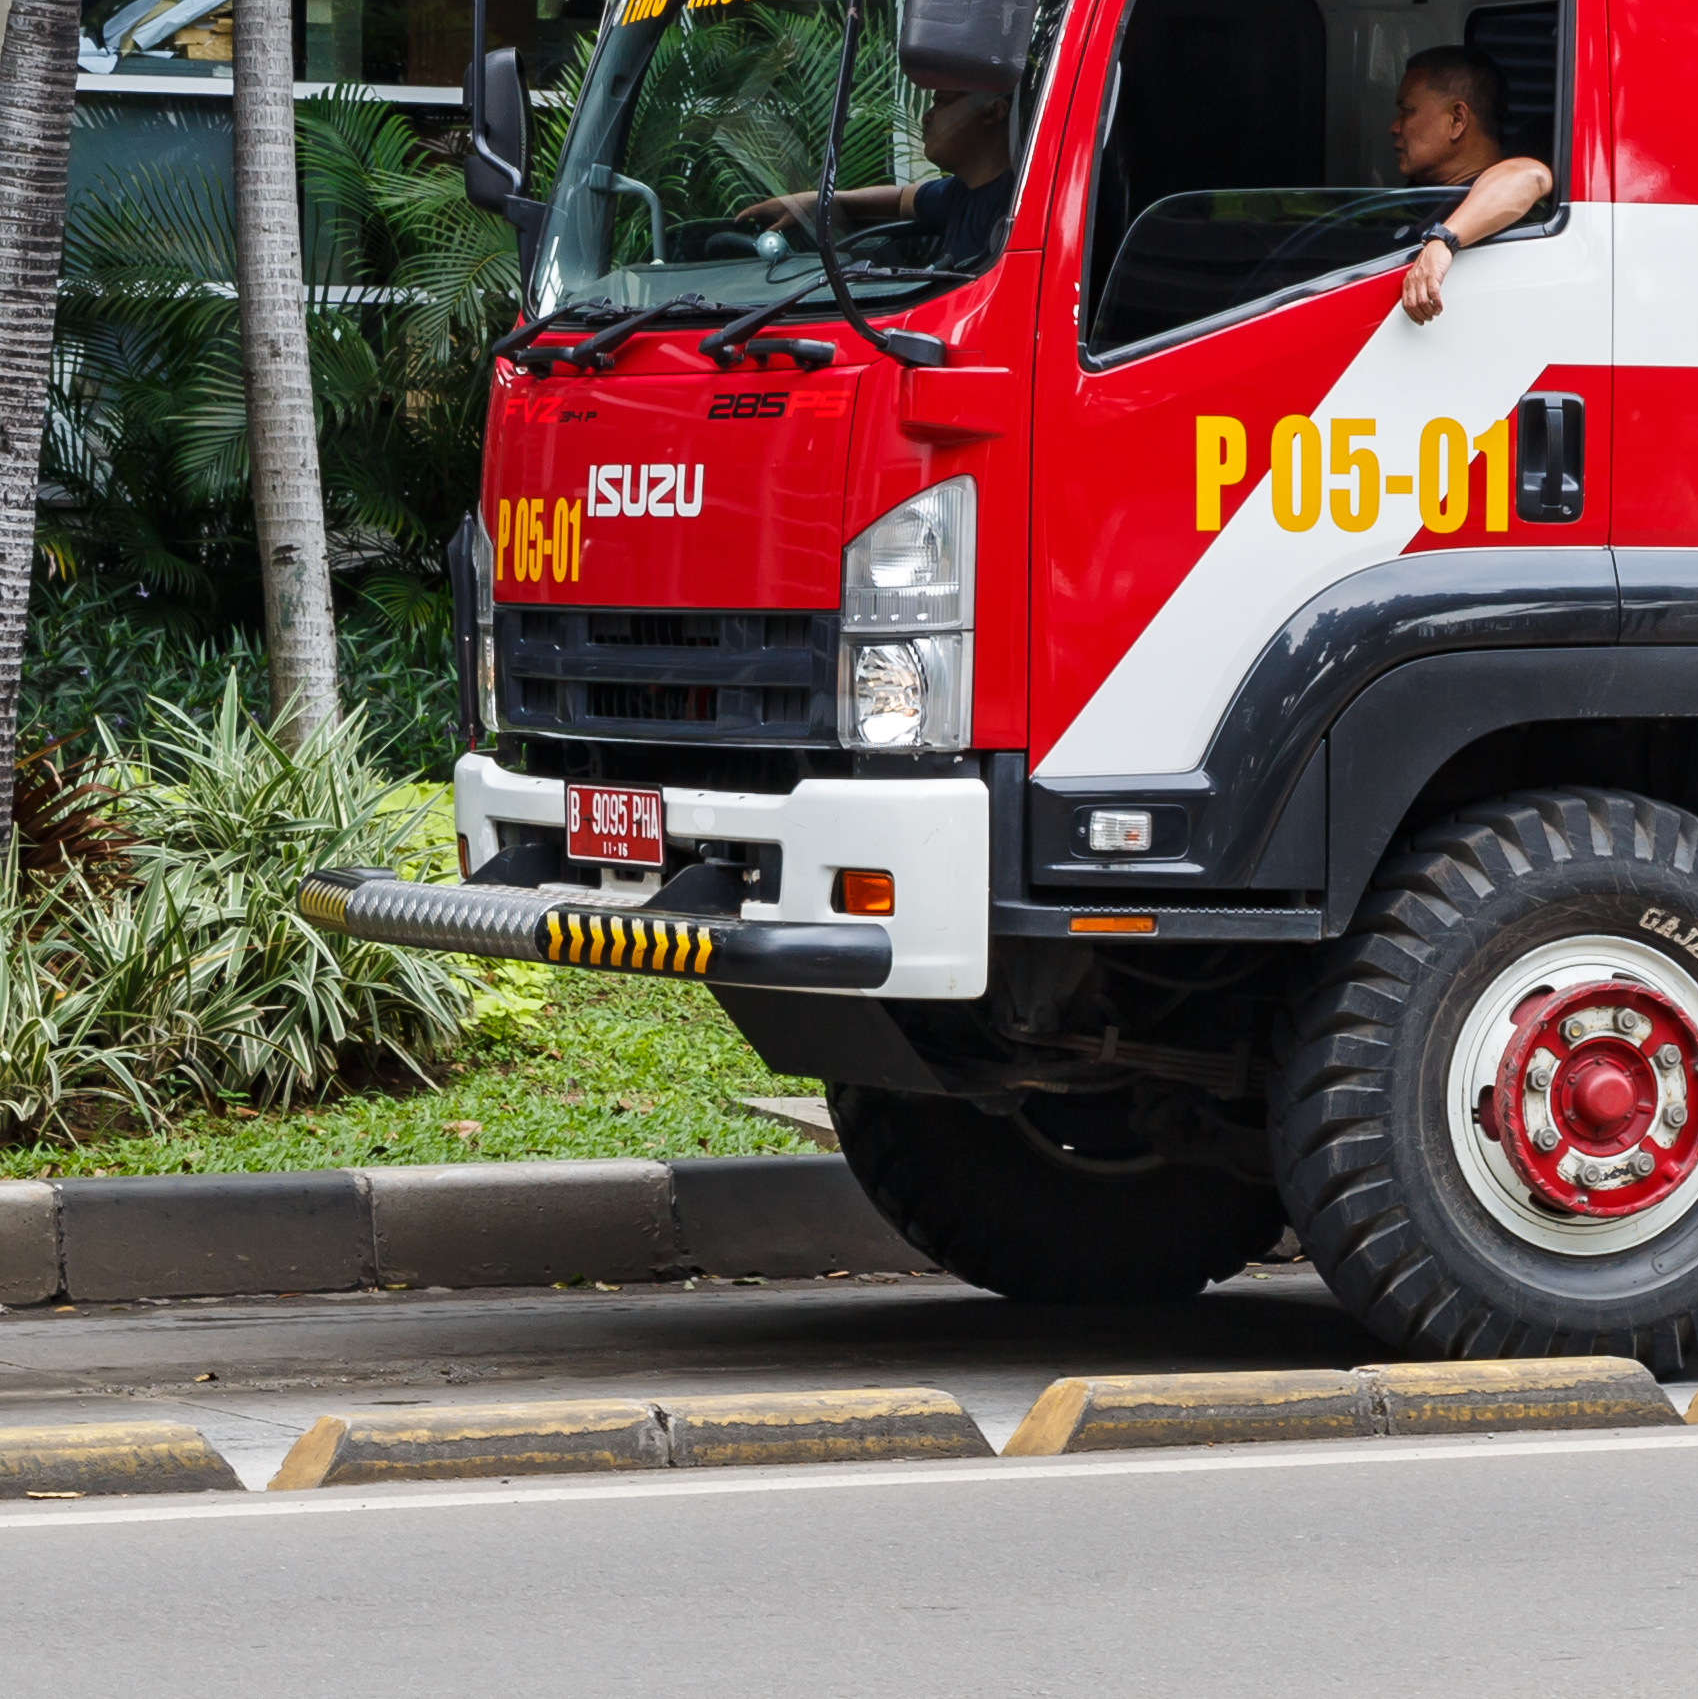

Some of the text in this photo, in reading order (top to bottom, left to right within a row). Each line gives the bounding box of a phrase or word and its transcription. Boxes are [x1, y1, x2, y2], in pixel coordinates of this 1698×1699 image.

[587, 464, 704, 517] ISUZU
[1196, 414, 1510, 534] P 05-01
[496, 496, 582, 583] P 05-01
[570, 790, 659, 840] B 9095 PHA
